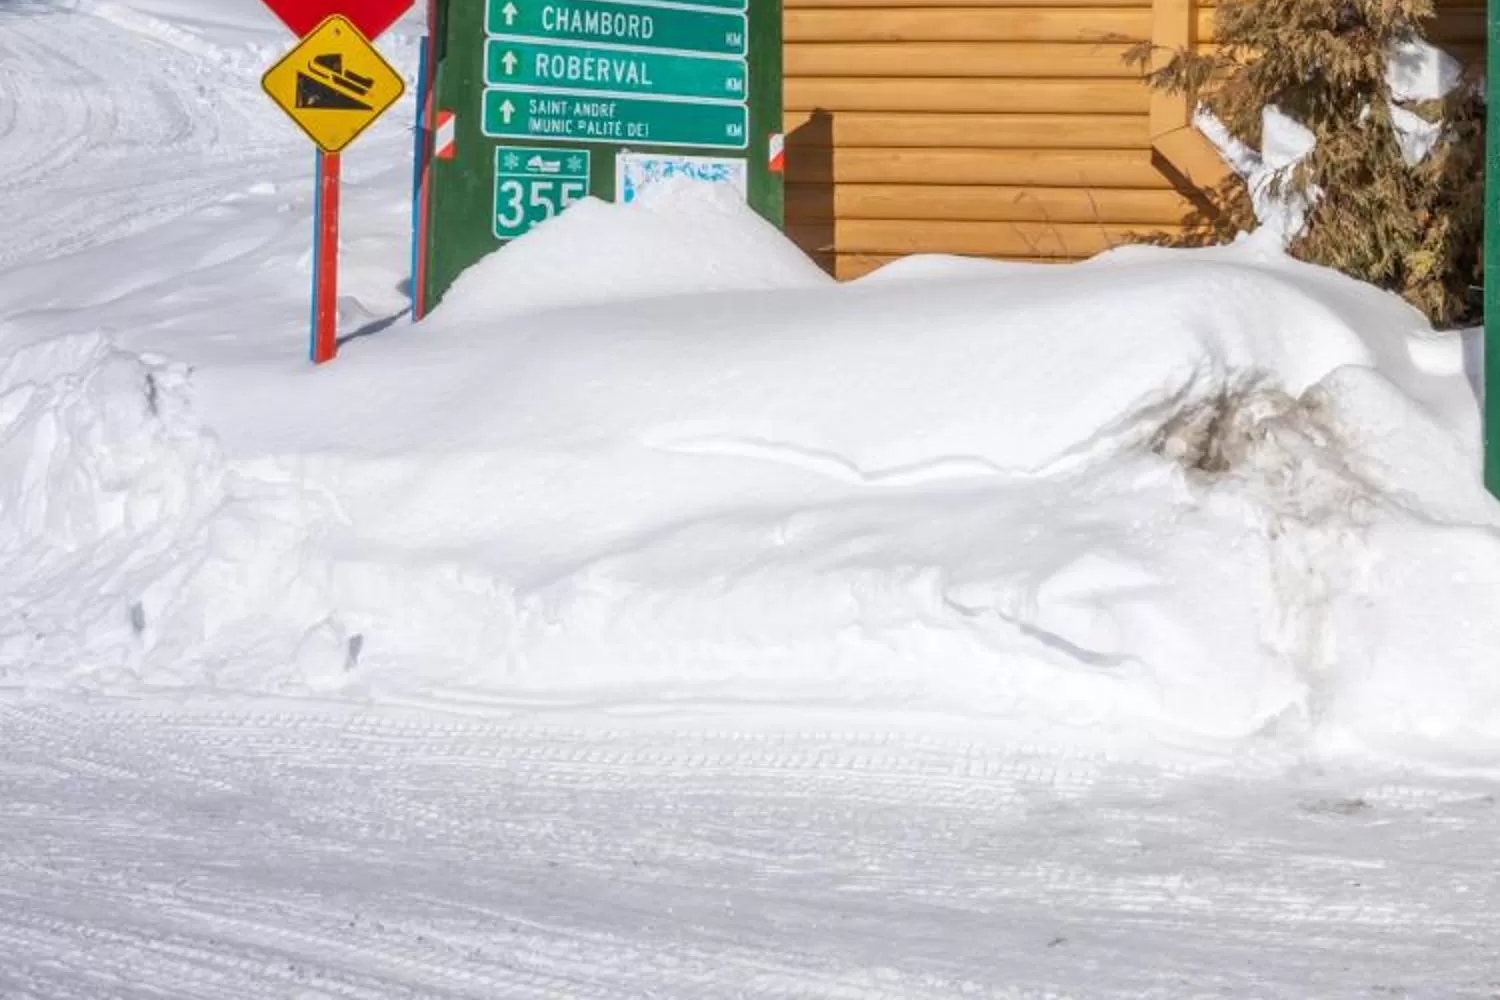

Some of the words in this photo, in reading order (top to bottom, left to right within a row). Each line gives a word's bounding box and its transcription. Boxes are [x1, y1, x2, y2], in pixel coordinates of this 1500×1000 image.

[542, 6, 654, 39] CHAMBORD
[725, 32, 743, 47] KM
[535, 53, 653, 85] ROBERVAL
[725, 77, 743, 92] KM
[725, 123, 743, 137] KM
